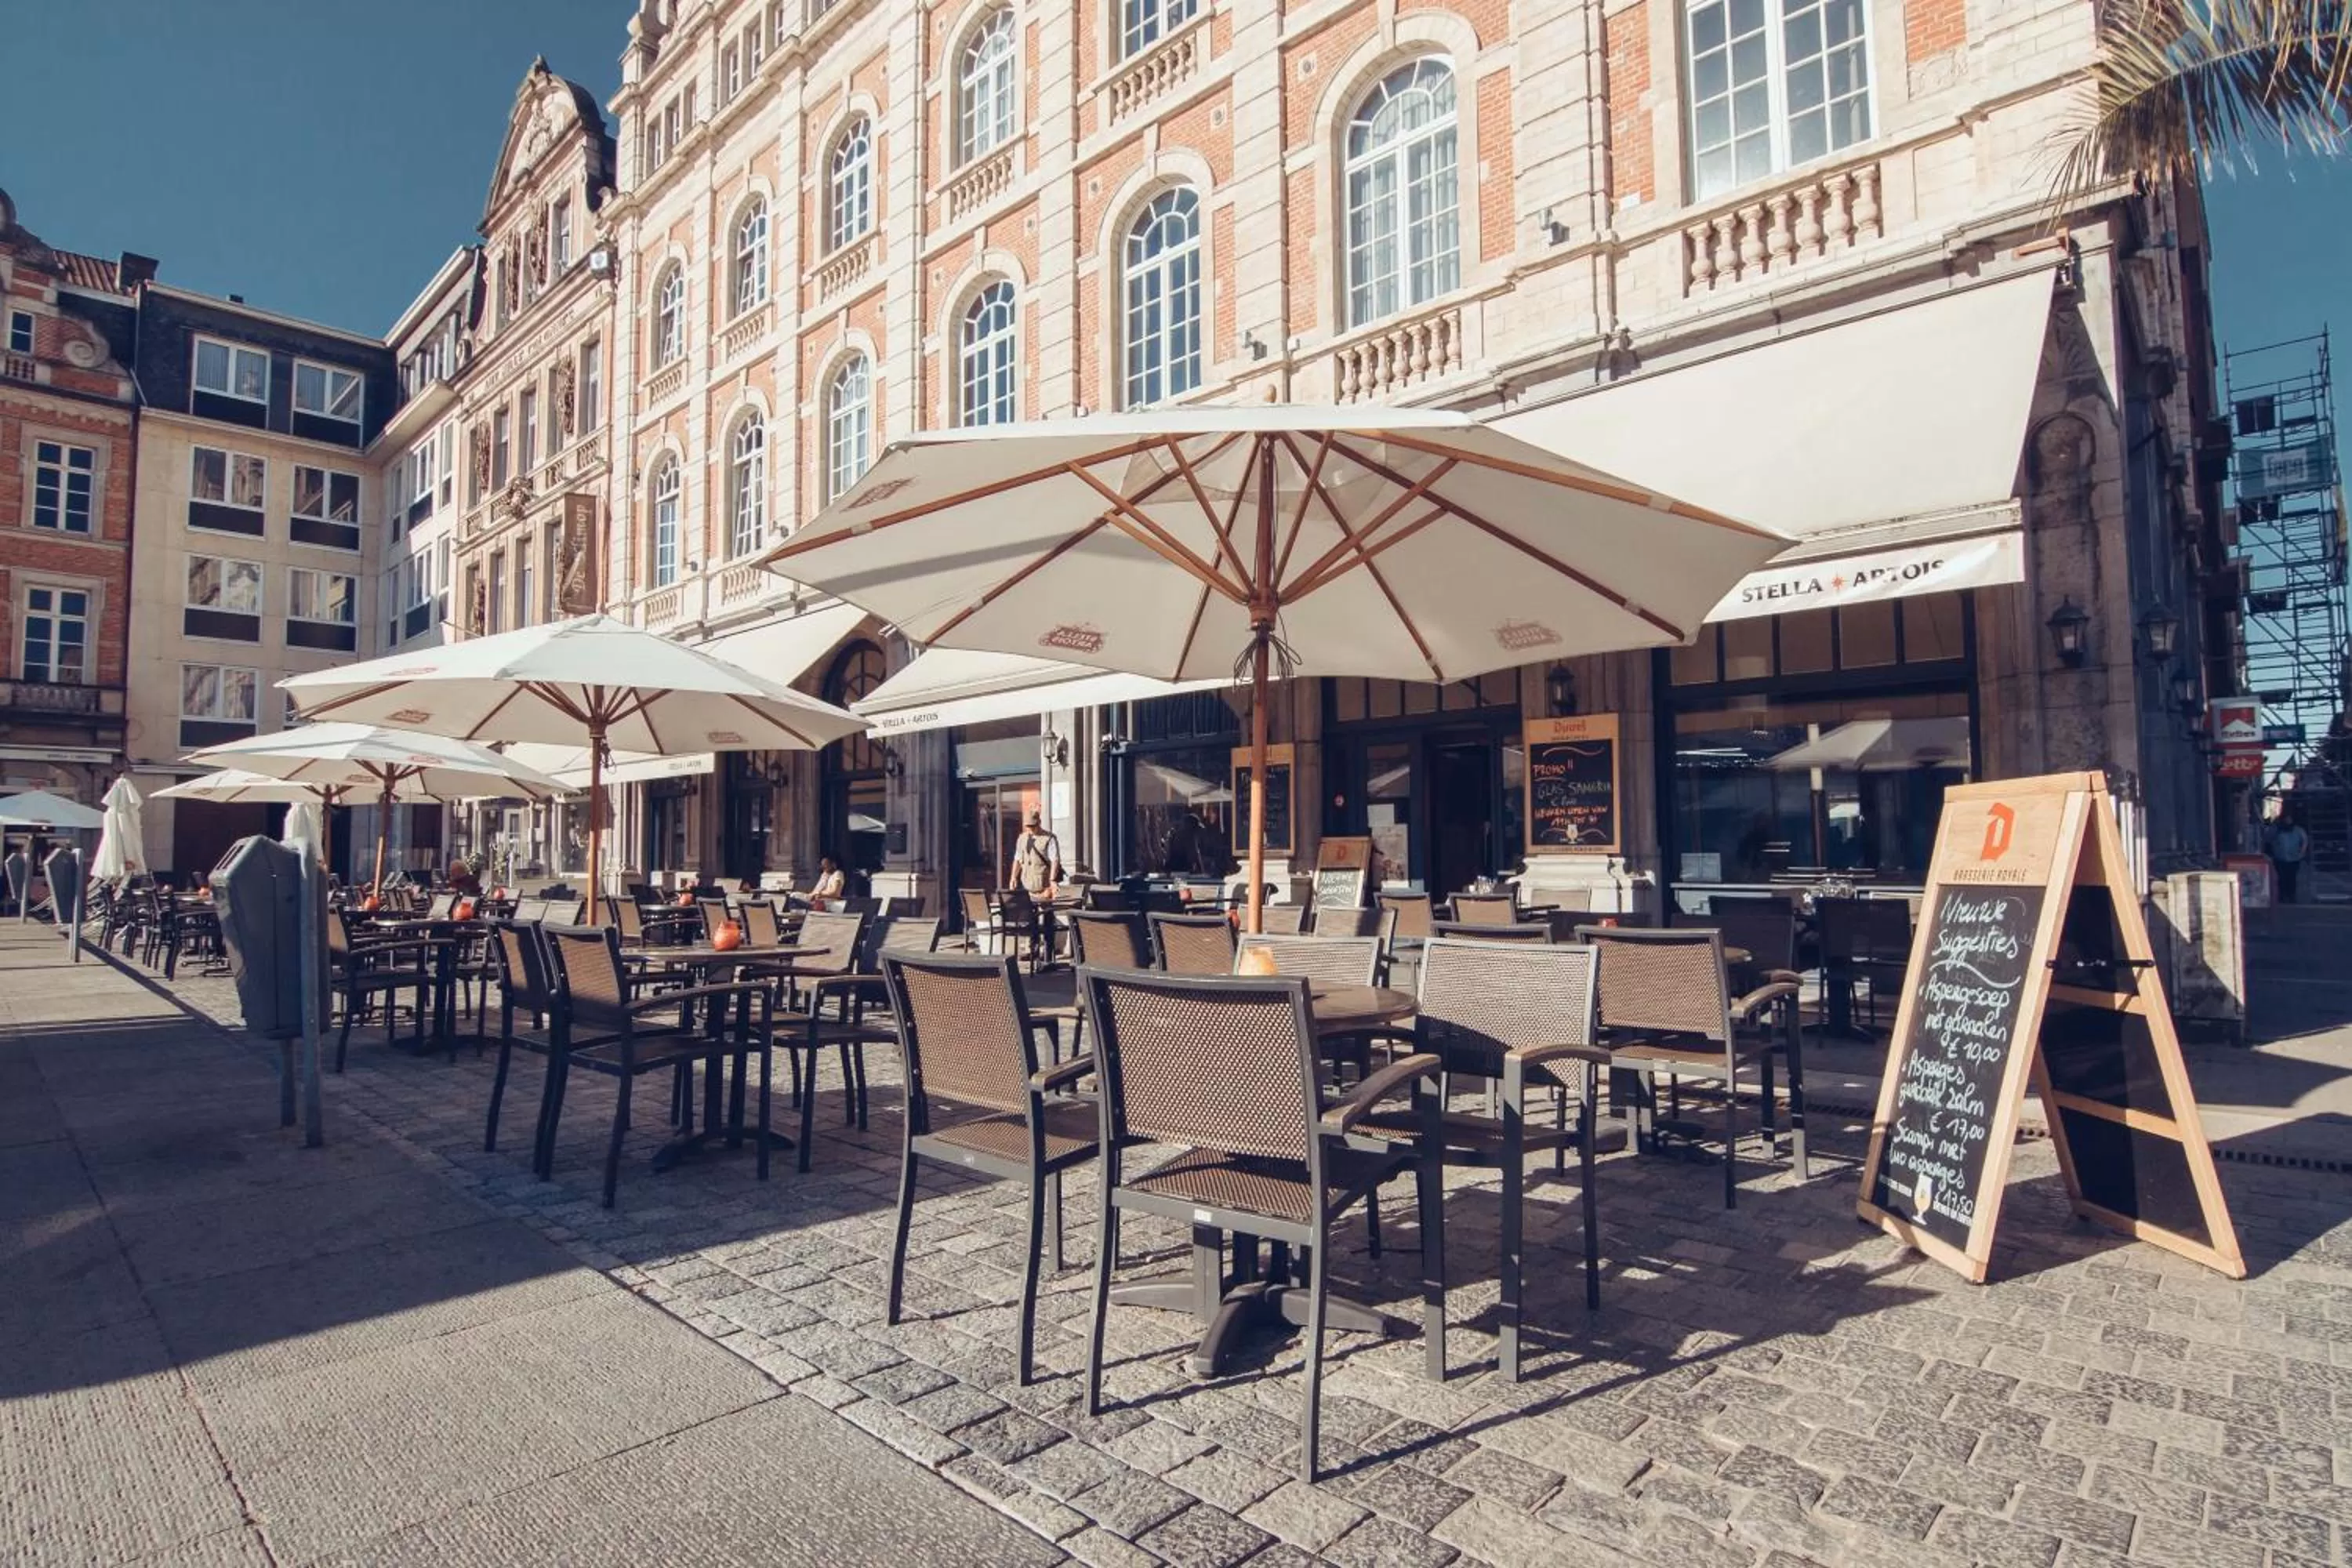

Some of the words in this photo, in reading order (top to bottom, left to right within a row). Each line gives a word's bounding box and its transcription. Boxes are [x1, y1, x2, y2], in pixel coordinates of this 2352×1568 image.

[1742, 578, 1824, 603] STELLA
[1940, 892, 2008, 924] Nieuwe
[1931, 925, 2019, 971] Suggesties
[1962, 1040, 2001, 1066] 10,00
[1929, 1111, 1944, 1133] €
[1946, 1118, 1986, 1145] 17,00
